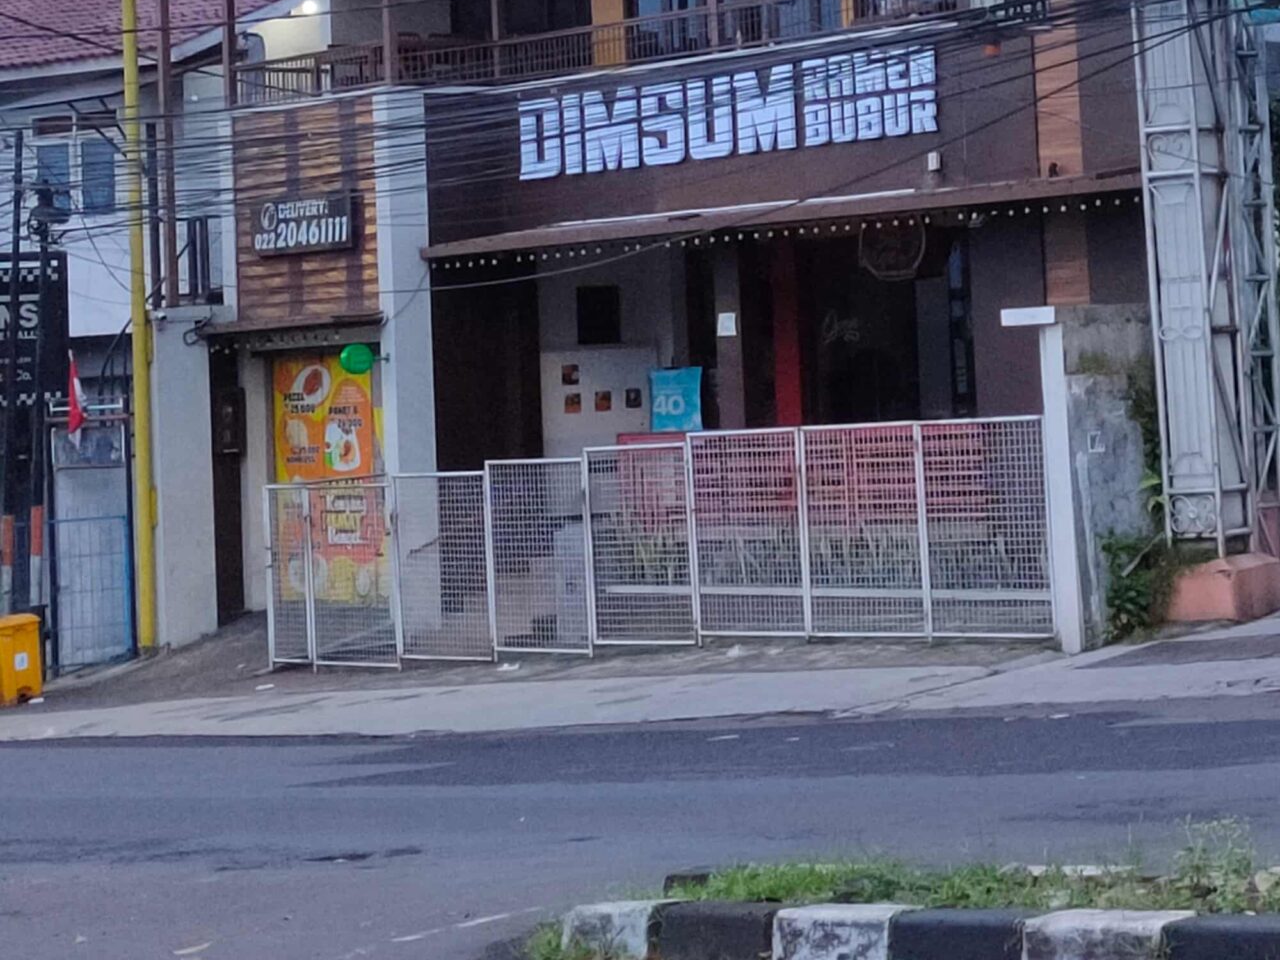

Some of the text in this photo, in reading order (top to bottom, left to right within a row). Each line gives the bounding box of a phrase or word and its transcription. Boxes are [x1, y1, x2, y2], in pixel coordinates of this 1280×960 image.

[801, 44, 937, 101] RAMEN
[517, 63, 798, 181] DIMSUM
[803, 89, 939, 147] BUBUR
[254, 215, 348, 251] 022 20461111
[652, 394, 686, 416] 40
